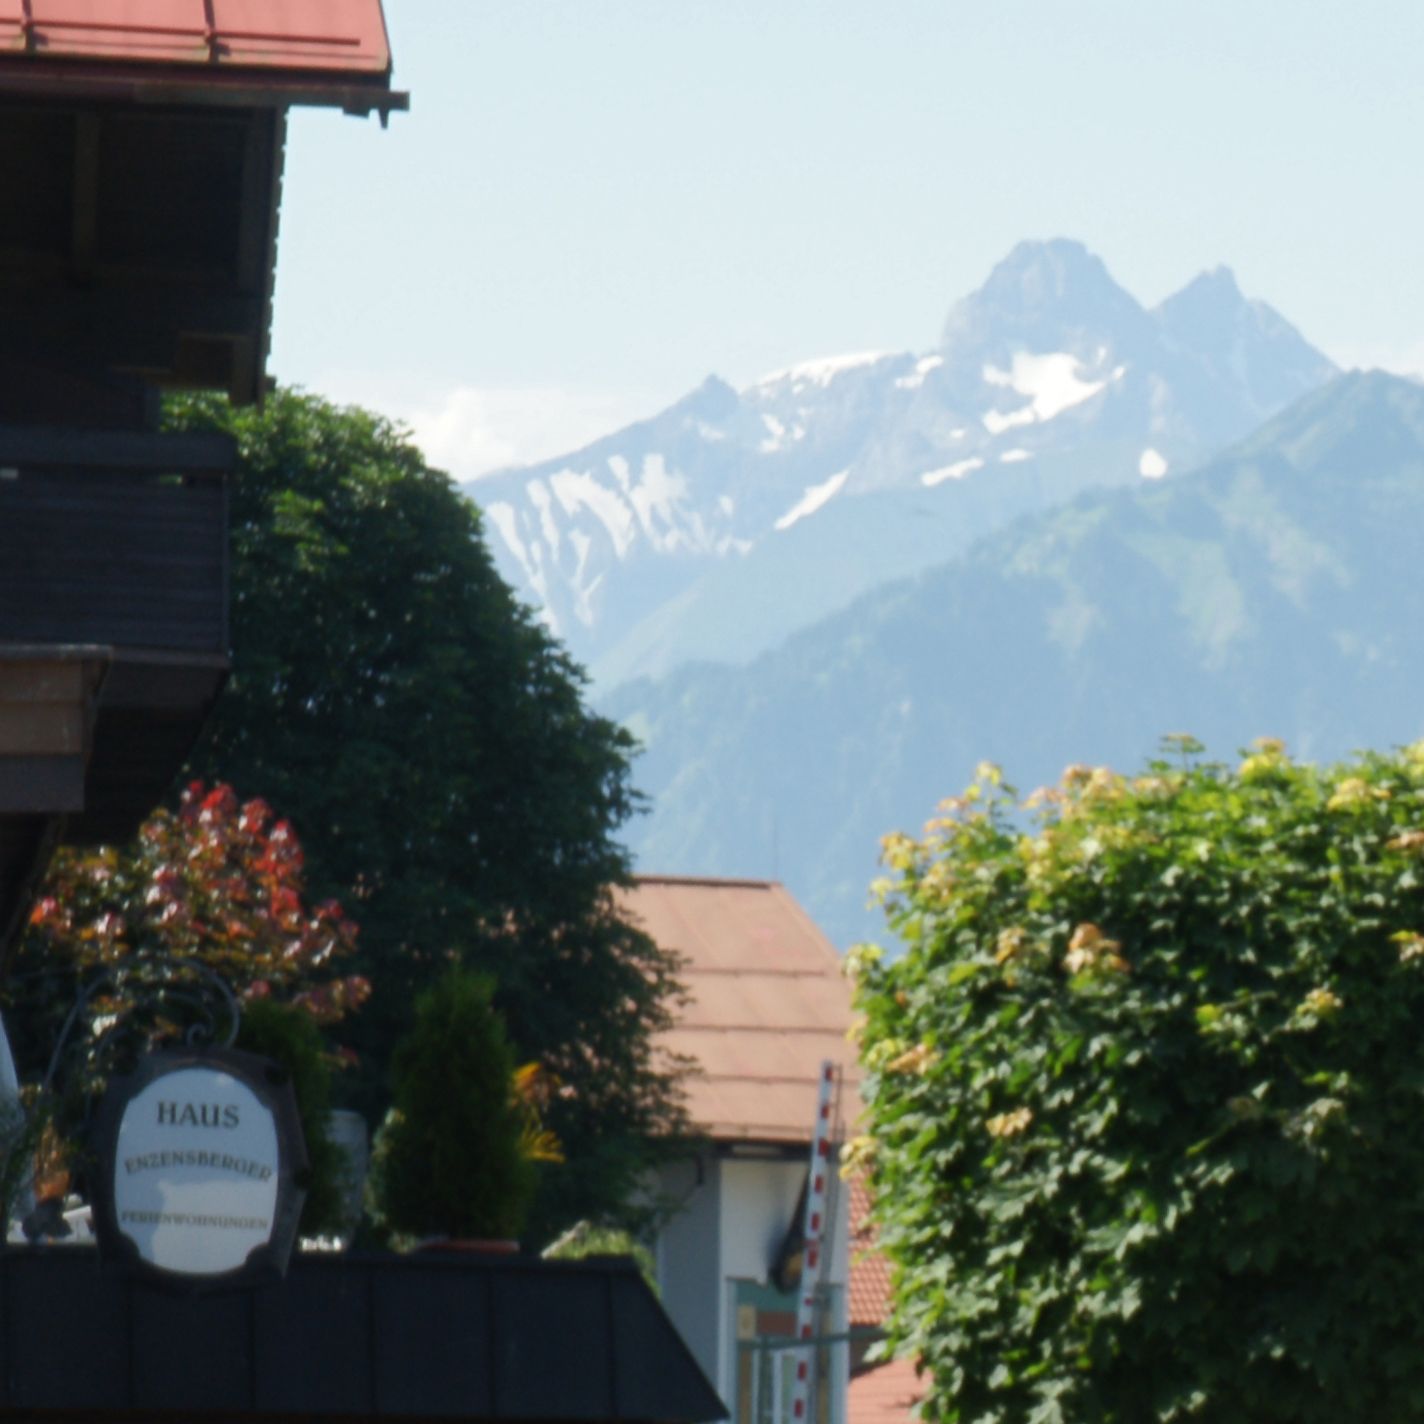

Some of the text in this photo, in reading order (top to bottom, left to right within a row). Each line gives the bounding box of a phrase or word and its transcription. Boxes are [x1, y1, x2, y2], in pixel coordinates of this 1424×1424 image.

[156, 1101, 240, 1128] HAUS
[125, 1150, 272, 1181] ENZENSBERGER
[121, 1210, 269, 1230] FERIENWOHNUNGEN
